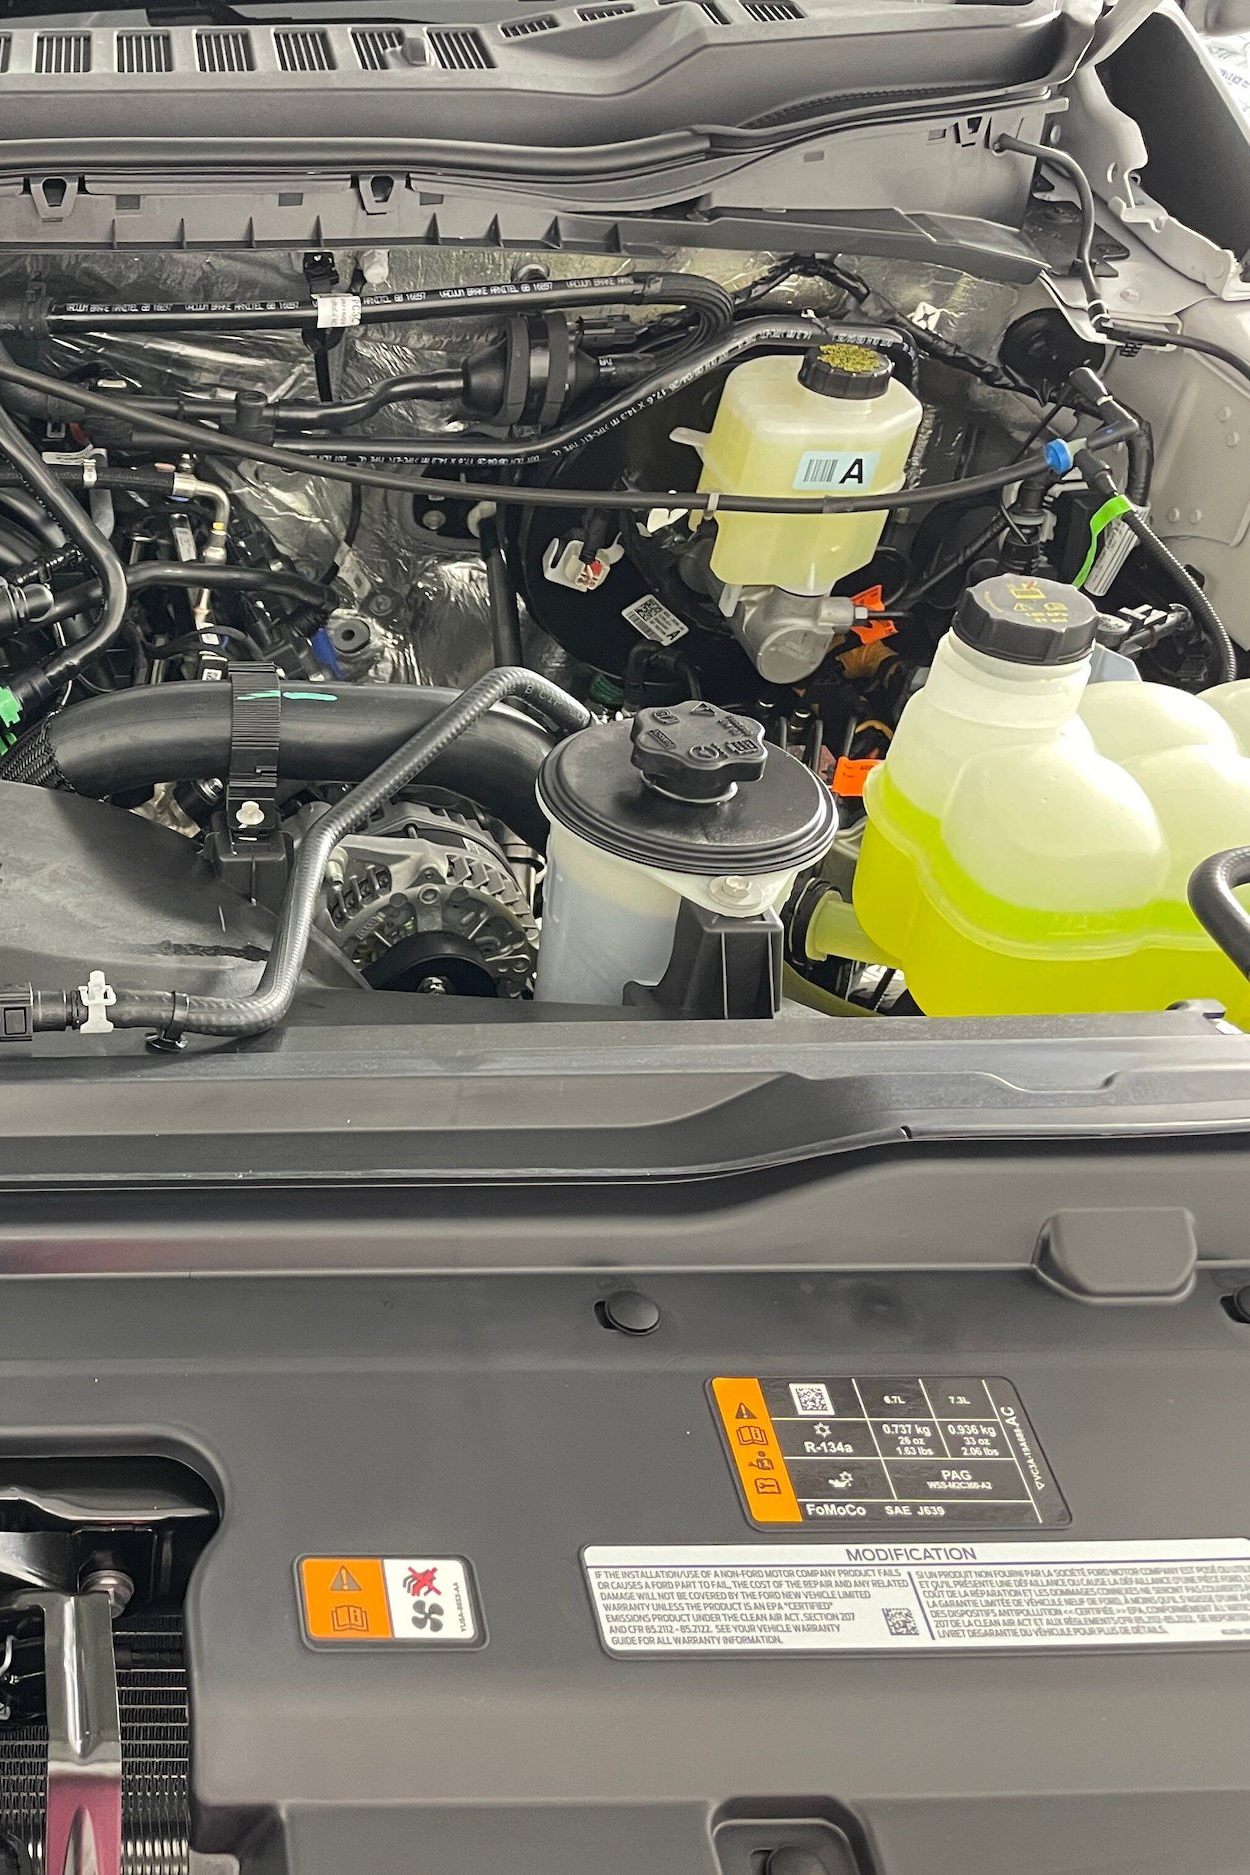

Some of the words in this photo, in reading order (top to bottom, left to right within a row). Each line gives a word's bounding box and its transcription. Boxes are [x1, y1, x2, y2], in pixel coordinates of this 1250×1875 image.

[439, 289, 466, 298] VACUUM
[466, 286, 488, 296] BRAKE
[646, 388, 666, 404] 17.6
[838, 458, 862, 484] A
[666, 630, 681, 640] A
[883, 1396, 906, 1404] 6.7L
[949, 1396, 970, 1405] 7.3L
[882, 1424, 912, 1435] 0.737
[915, 1424, 932, 1437] kg
[948, 1424, 978, 1435] 0.936
[980, 1424, 996, 1437] kg
[898, 1437, 911, 1445] 26
[964, 1437, 976, 1445] 33
[804, 1442, 854, 1453] R-134a
[896, 1447, 916, 1455] 1.63
[918, 1447, 934, 1456] lbs
[961, 1447, 981, 1456] 2.06
[984, 1447, 999, 1456] lbs
[941, 1470, 972, 1480] PAG
[806, 1504, 866, 1516] FoMoCo
[885, 1506, 912, 1515] SAE
[917, 1506, 946, 1516] J639
[846, 1548, 977, 1561] MODIFICATION
[595, 1570, 602, 1579] IF
[603, 1570, 620, 1578] THE
[622, 1570, 700, 1578] INSTALLATION/USE
[701, 1570, 712, 1578] OF
[713, 1570, 720, 1578] A
[720, 1570, 764, 1578] NON-FORD
[764, 1569, 795, 1578] MOTOR
[796, 1569, 836, 1578] COMPANY
[838, 1569, 876, 1577] PRODUCT
[878, 1569, 901, 1577] FAILS
[915, 1571, 924, 1579] SI
[924, 1570, 937, 1579] UN
[937, 1570, 973, 1579] PRODUIT
[974, 1570, 993, 1578] NON
[994, 1569, 1024, 1578] FOURNI
[1025, 1569, 1041, 1577] PAR
[1042, 1569, 1053, 1577] LA
[598, 1581, 610, 1590] OR
[611, 1581, 643, 1590] CAUSES
[645, 1581, 651, 1590] A
[652, 1580, 674, 1589] FORD
[675, 1580, 697, 1589] PART
[698, 1580, 711, 1589] TO
[732, 1580, 749, 1589] THE
[750, 1580, 771, 1589] COST
[773, 1580, 784, 1589] OF
[786, 1580, 803, 1588] THE
[803, 1580, 833, 1588] REPAIR
[834, 1580, 852, 1588] AND
[854, 1580, 870, 1588] ANY
[872, 1579, 909, 1588] RELATED
[919, 1581, 929, 1589] ET
[954, 1578, 996, 1588] PRÉSENTE
[996, 1579, 1012, 1588] UNE
[600, 1592, 635, 1601] DAMAGE
[636, 1591, 658, 1600] WILL
[658, 1591, 675, 1600] NOT
[677, 1591, 687, 1600] BE
[688, 1591, 727, 1600] COVERED
[729, 1591, 739, 1600] BY
[740, 1591, 758, 1600] THE
[758, 1591, 781, 1600] FORD
[782, 1591, 801, 1600] NEW
[804, 1591, 837, 1600] VEHICLE
[838, 1591, 871, 1599] LIMITED
[946, 1590, 957, 1598] DE
[958, 1590, 969, 1598] LA
[970, 1588, 1022, 1598] RÉPARATION
[1023, 1589, 1033, 1597] ET
[603, 1602, 650, 1612] WARRANTY
[651, 1602, 684, 1611] UNLESS
[685, 1602, 702, 1611] THE
[703, 1602, 742, 1611] PRODUCT
[744, 1602, 752, 1611] IS
[753, 1602, 766, 1611] AN
[766, 1602, 784, 1611] EPA
[926, 1600, 938, 1608] LA
[939, 1599, 979, 1608] GARANTIE
[980, 1597, 1011, 1607] LIMITÉE
[1012, 1598, 1024, 1607] DE
[605, 1614, 652, 1622] EMISSIONS
[651, 1613, 691, 1622] PRODUCT
[692, 1613, 722, 1622] UNDER
[722, 1613, 739, 1622] THE
[740, 1613, 768, 1622] CLEAN
[769, 1613, 782, 1622] AIR
[804, 1613, 839, 1622] SECTION
[839, 1613, 855, 1622] 207
[930, 1609, 947, 1618] DES
[947, 1609, 997, 1617] DISPOSITIFS
[998, 1608, 1063, 1616] ANTIPOLLUTION
[950, 1619, 962, 1628] DE
[962, 1619, 973, 1627] LA
[974, 1618, 1001, 1627] CLEAN
[1002, 1618, 1015, 1627] AIR
[1017, 1618, 1032, 1626] ACT
[1033, 1618, 1043, 1626] ET
[610, 1625, 627, 1634] AND
[628, 1625, 644, 1634] CFR
[715, 1624, 730, 1633] SEE
[732, 1624, 756, 1633] YOUR
[758, 1624, 792, 1633] VEHICLE
[793, 1624, 841, 1633] WARRANTY
[937, 1629, 965, 1638] LIVRET
[1019, 1628, 1032, 1636] DU
[611, 1636, 639, 1645] GUIDE
[639, 1636, 655, 1645] FOR
[657, 1636, 673, 1645] ALL
[674, 1636, 721, 1645] WARRANTY
[722, 1635, 783, 1644] INFORMATION.
